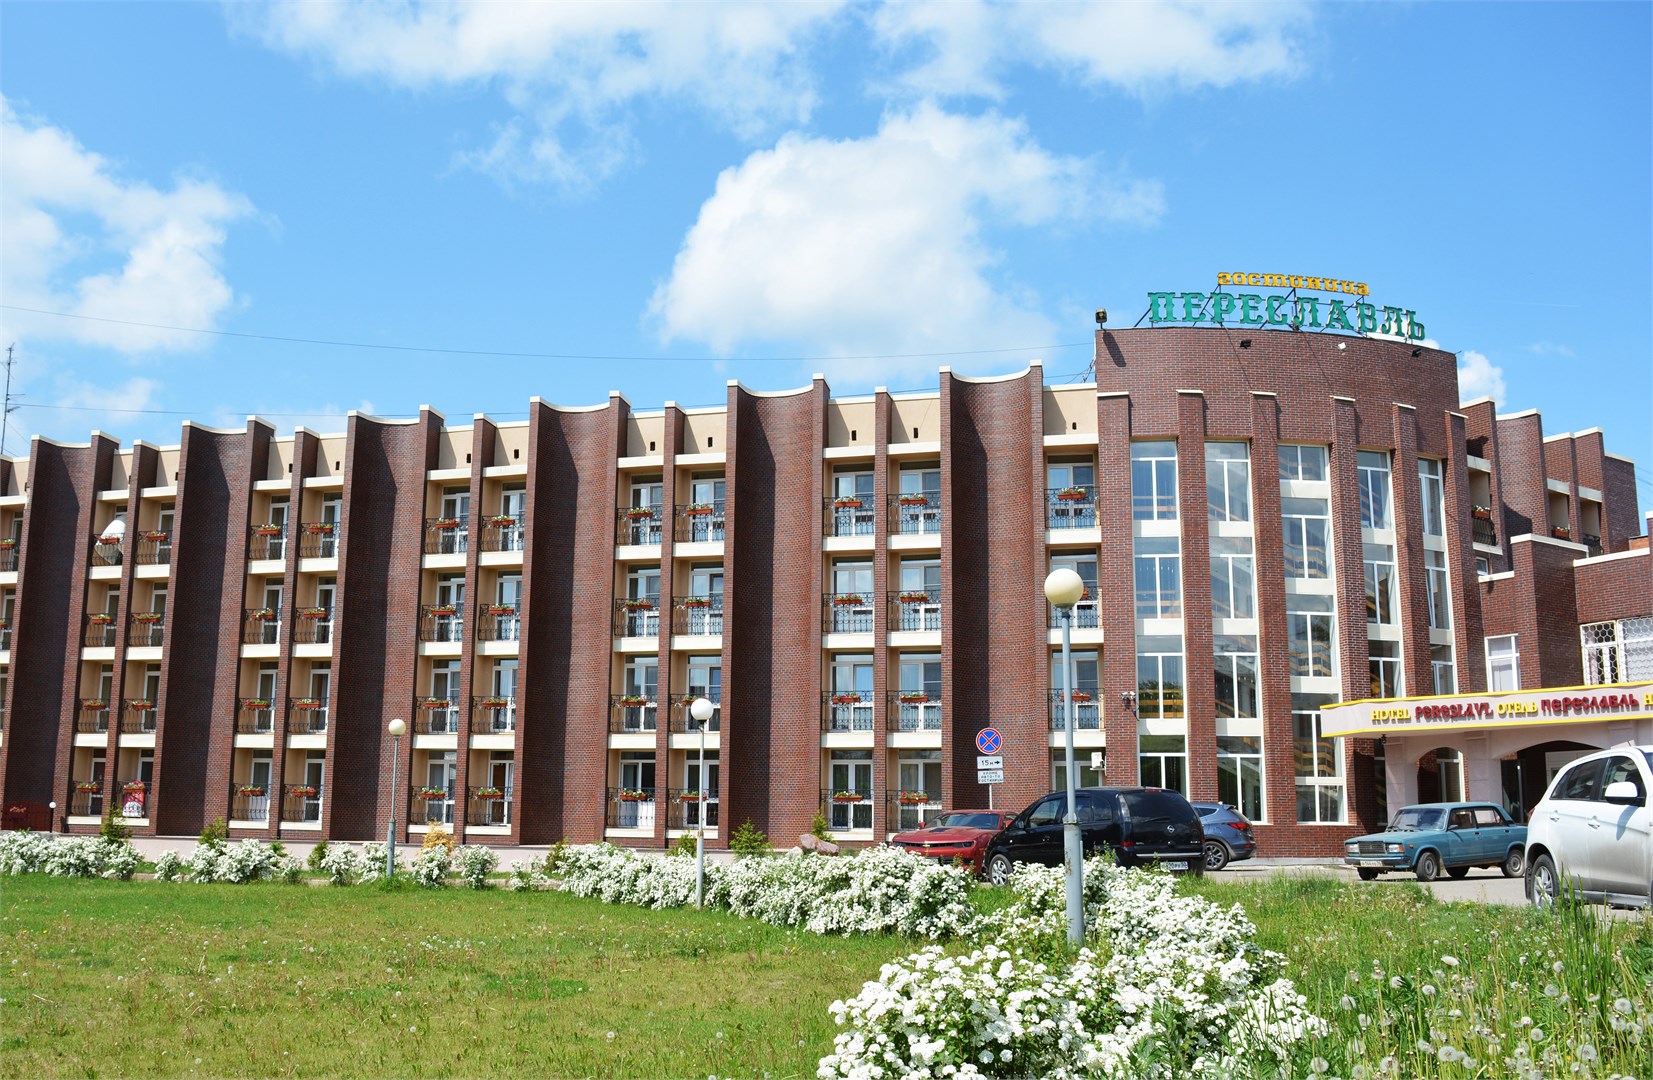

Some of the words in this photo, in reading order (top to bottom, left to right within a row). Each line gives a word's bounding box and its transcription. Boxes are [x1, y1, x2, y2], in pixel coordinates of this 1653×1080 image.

[1217, 271, 1370, 296] гостиница
[1148, 291, 1426, 341] ПЕРЕСЛАВЛЬ
[1371, 708, 1411, 721] HOTEL
[1497, 701, 1538, 715] ОТЕЛЬ
[1541, 694, 1639, 711] ПЕРЕСЛАВЛЬ
